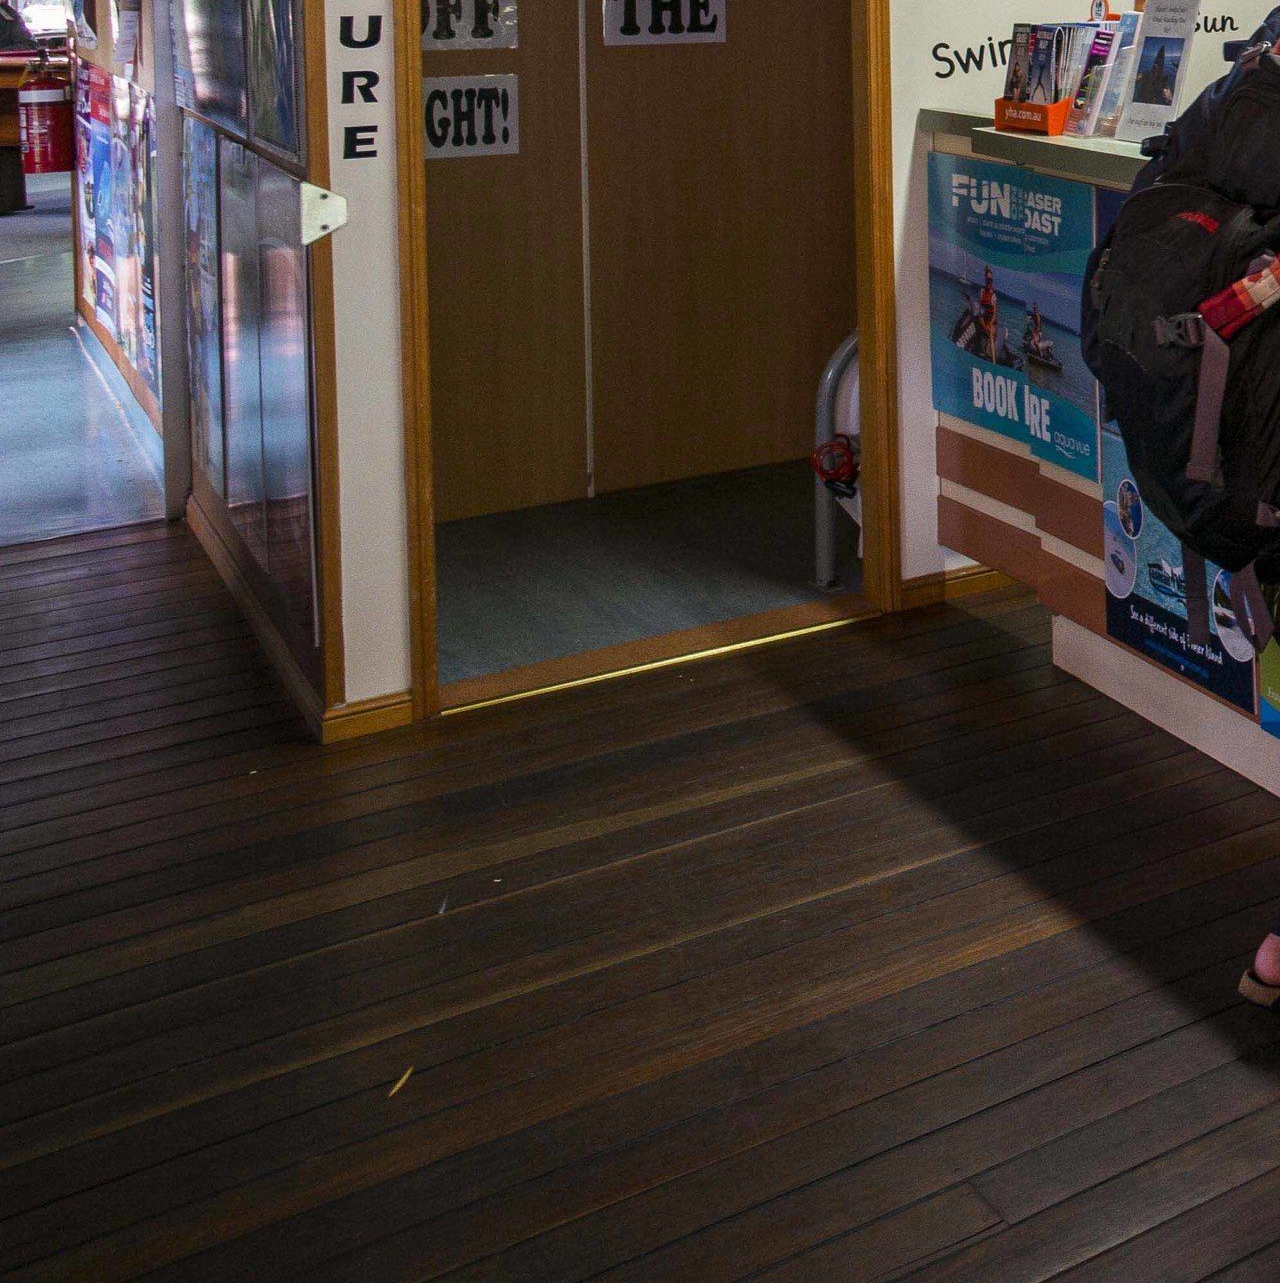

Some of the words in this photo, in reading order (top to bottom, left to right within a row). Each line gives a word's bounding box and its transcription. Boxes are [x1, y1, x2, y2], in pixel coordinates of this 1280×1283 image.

[1194, 13, 1239, 34] un
[1005, 105, 1042, 123] yha.com.au
[952, 173, 1011, 219] FUN
[972, 367, 1019, 422] BOOK
